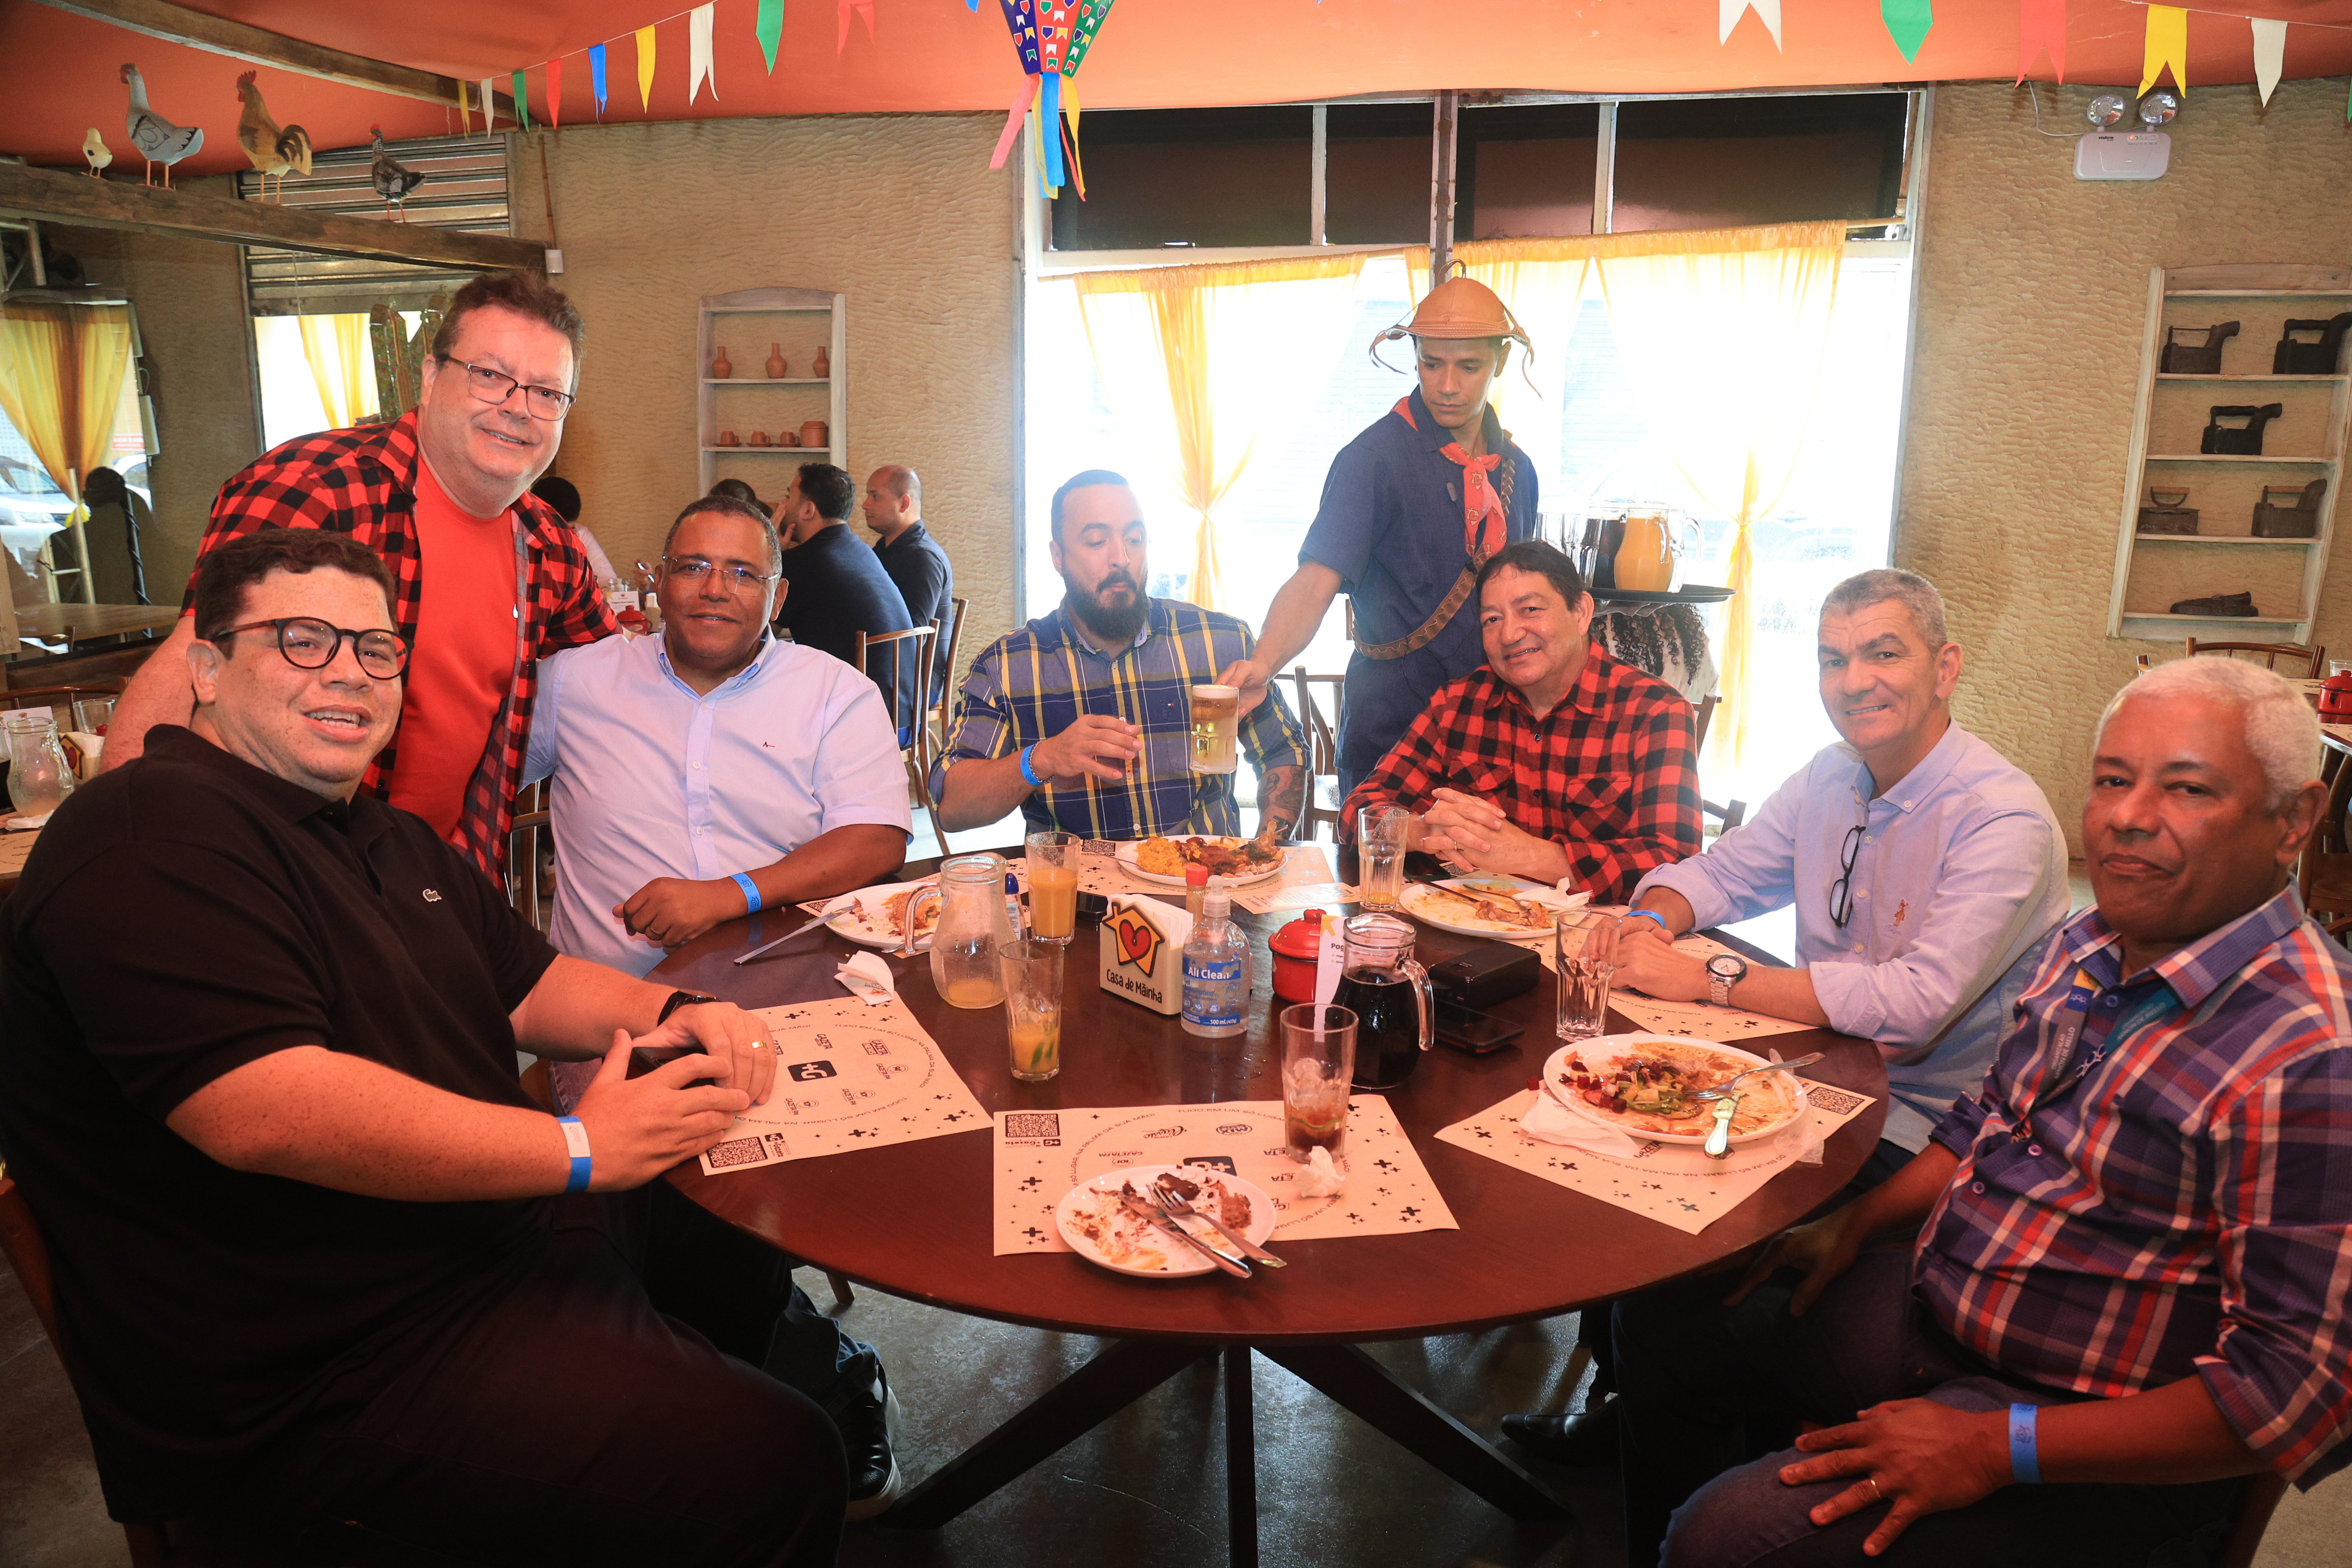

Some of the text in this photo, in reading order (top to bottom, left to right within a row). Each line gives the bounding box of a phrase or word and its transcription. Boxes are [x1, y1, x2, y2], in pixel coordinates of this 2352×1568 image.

[1331, 943, 1345, 952] Pag
[1188, 967, 1230, 980] All Clean
[1107, 969, 1123, 987] Casa
[1125, 977, 1134, 992] de
[1136, 981, 1162, 1004] Mãinha
[817, 1034, 833, 1050] GAZETA
[2064, 1026, 2076, 1048] MELLO
[862, 1043, 877, 1055] NEWS
[871, 1040, 889, 1056] GAZETA
[923, 1046, 934, 1062] PALMA
[876, 1063, 888, 1076] GAZETA
[842, 1089, 853, 1101] GAZETA
[785, 1098, 797, 1112] GAZETA
[887, 1097, 908, 1107] TUDO
[1143, 1126, 1187, 1139] Classic
[1082, 1132, 1104, 1148] PALMA
[1602, 1158, 1621, 1167] SUA
[1642, 1168, 1680, 1176] PALMA
[1325, 1200, 1337, 1208] EM
